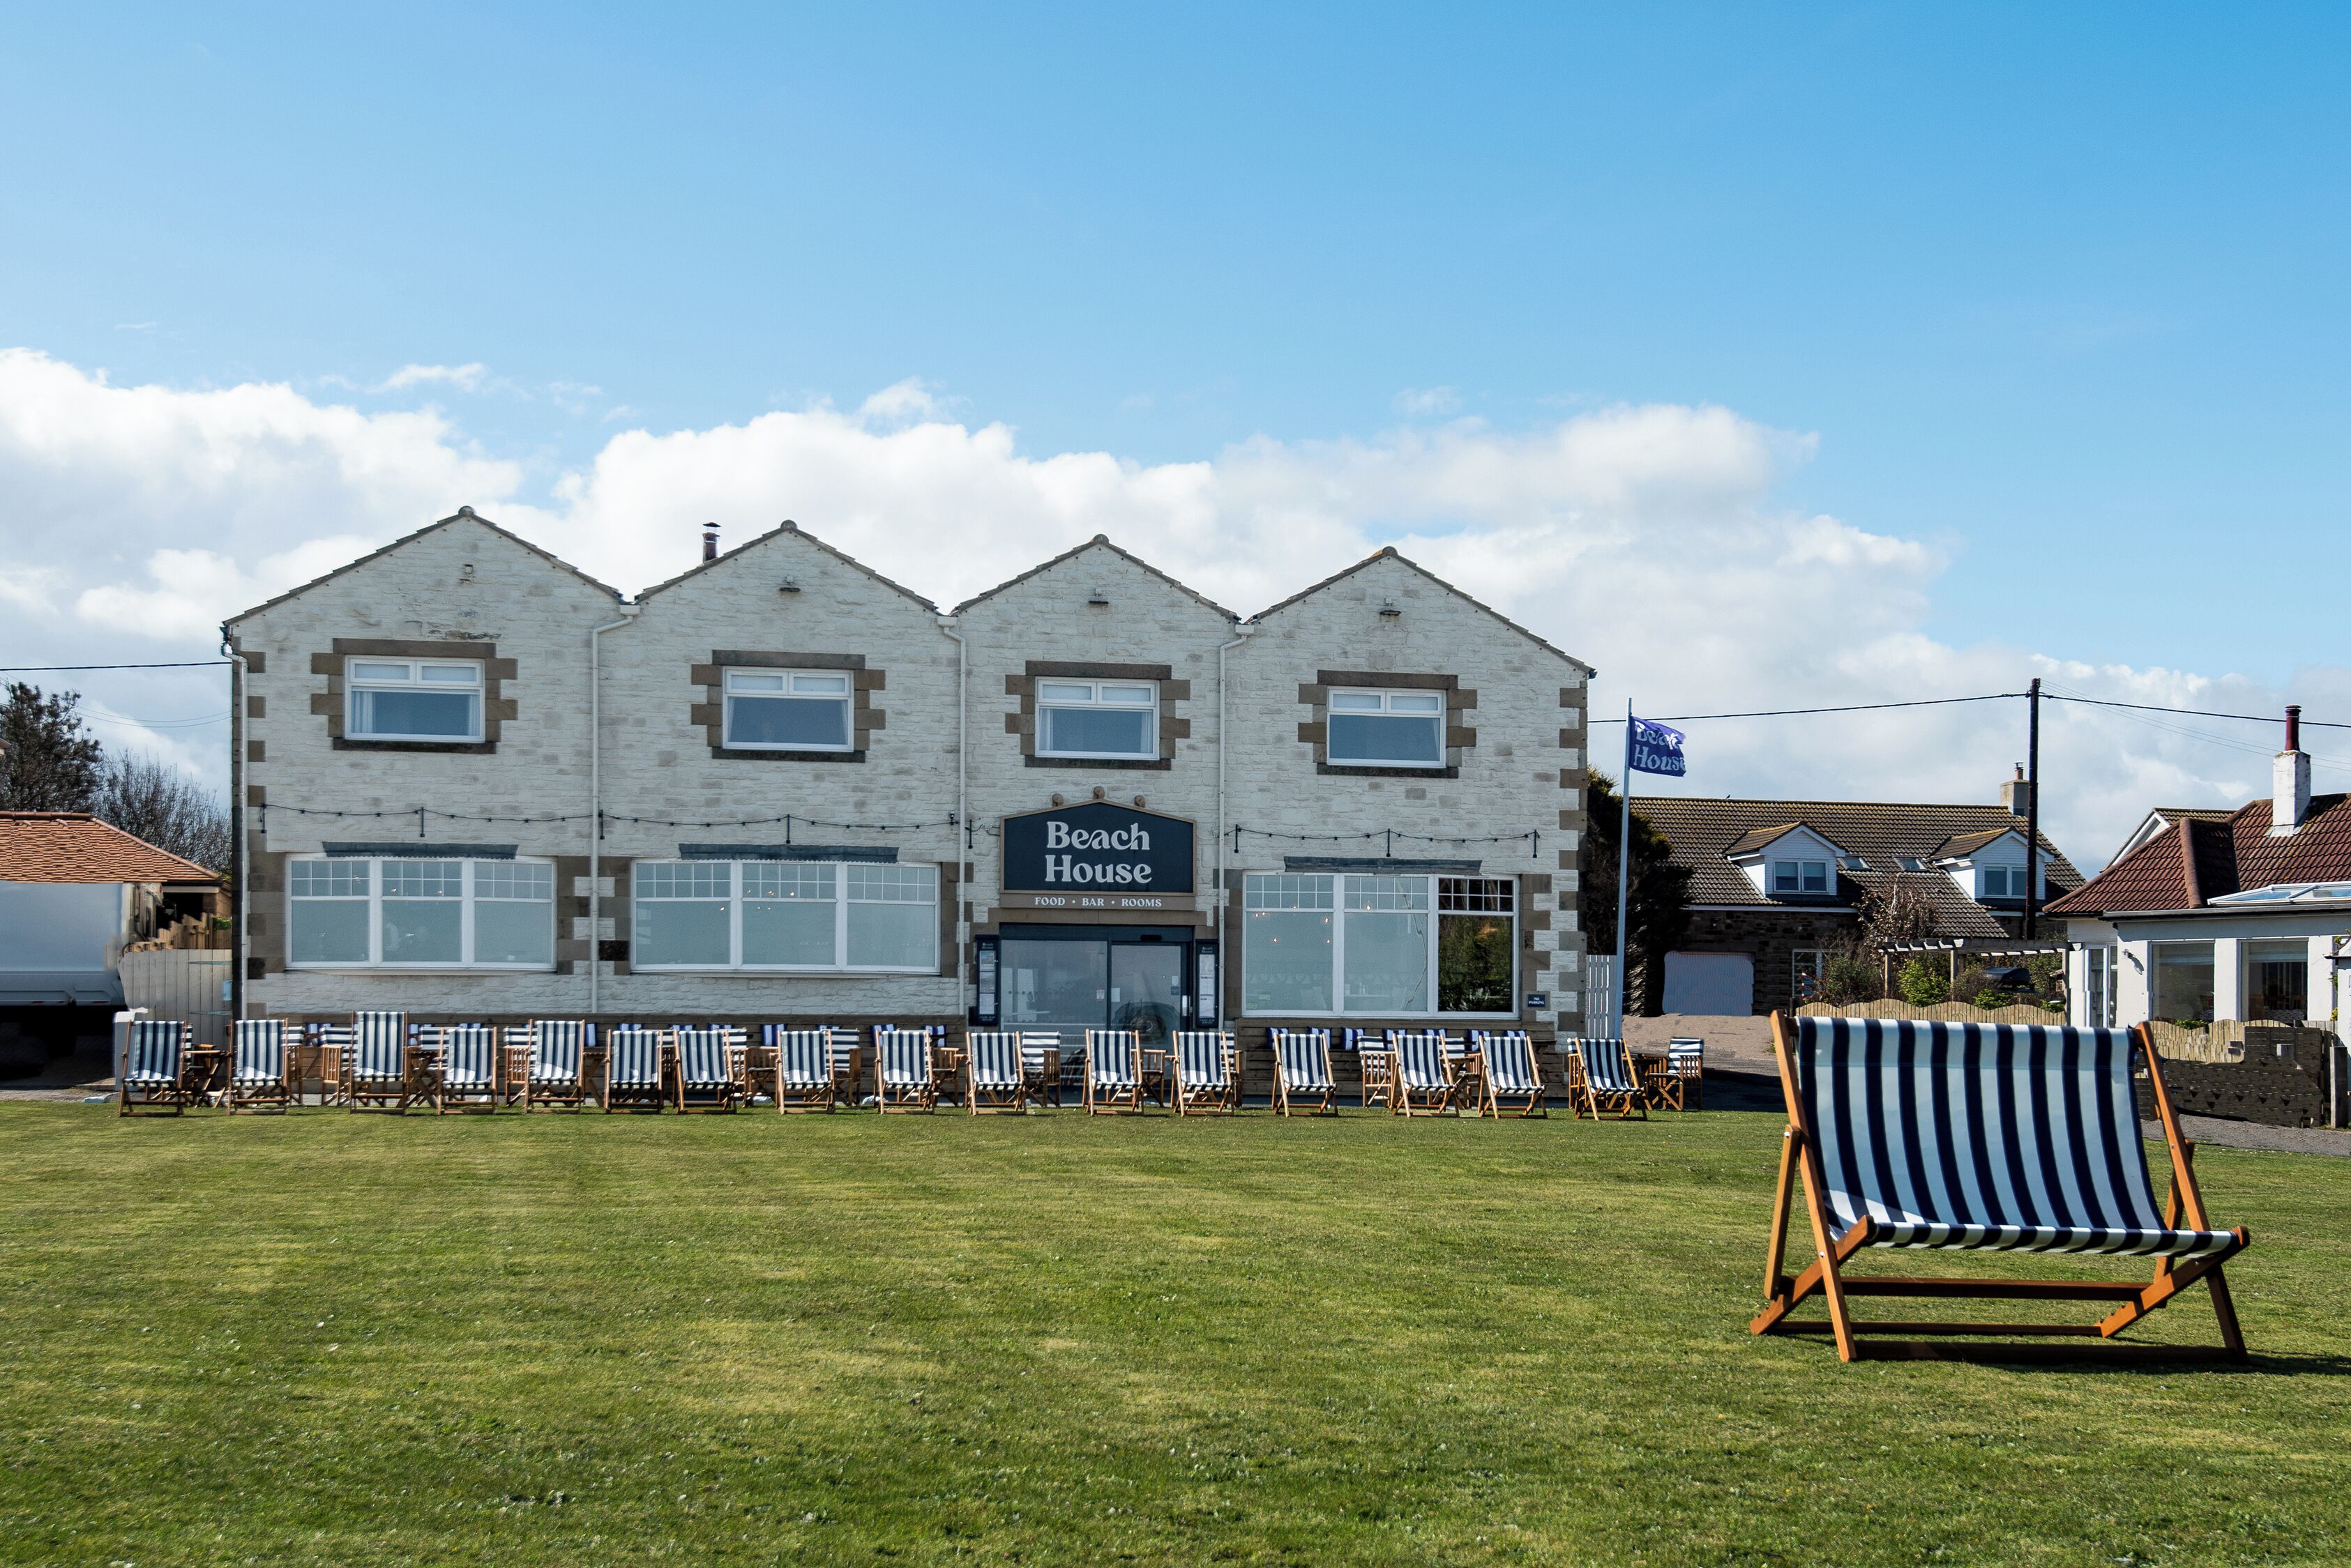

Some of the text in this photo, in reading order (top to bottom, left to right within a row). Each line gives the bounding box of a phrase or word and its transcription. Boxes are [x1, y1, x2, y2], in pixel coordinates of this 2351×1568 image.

[1633, 744, 1685, 770] House
[1046, 821, 1150, 850] Beach
[1045, 854, 1152, 883] House
[1035, 897, 1162, 907] FOOD BAR ROOMS
